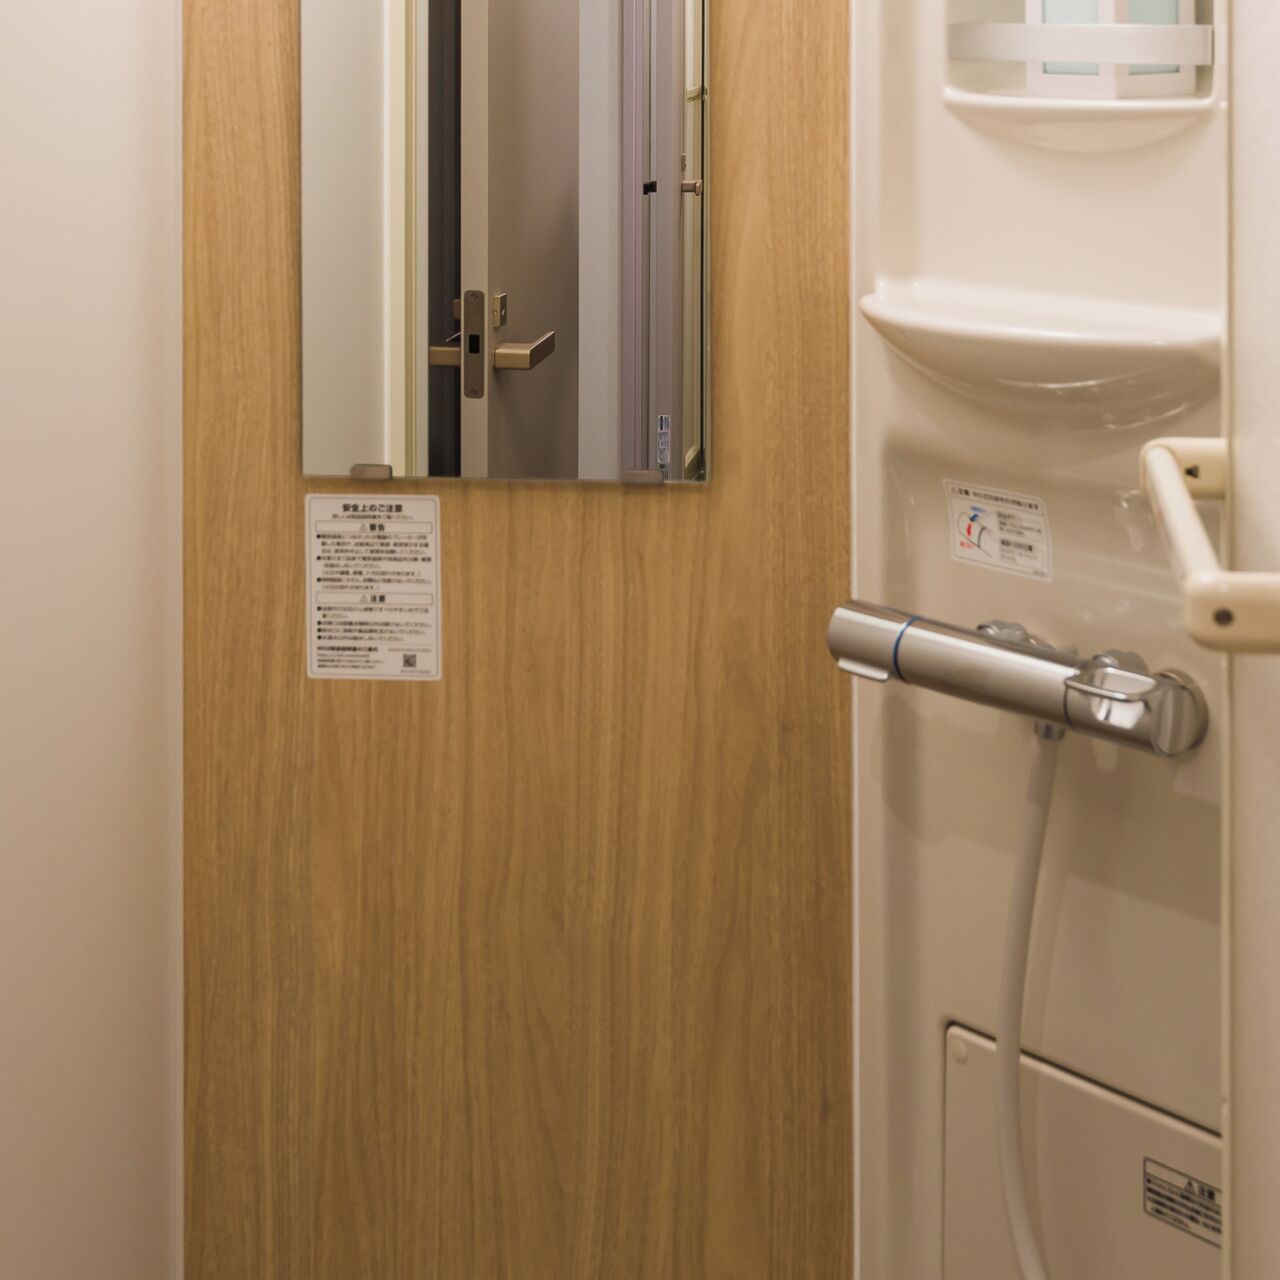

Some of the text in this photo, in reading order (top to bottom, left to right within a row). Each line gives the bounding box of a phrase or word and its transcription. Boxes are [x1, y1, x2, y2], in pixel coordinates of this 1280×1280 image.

[342, 504, 403, 513] 安全上のご注意
